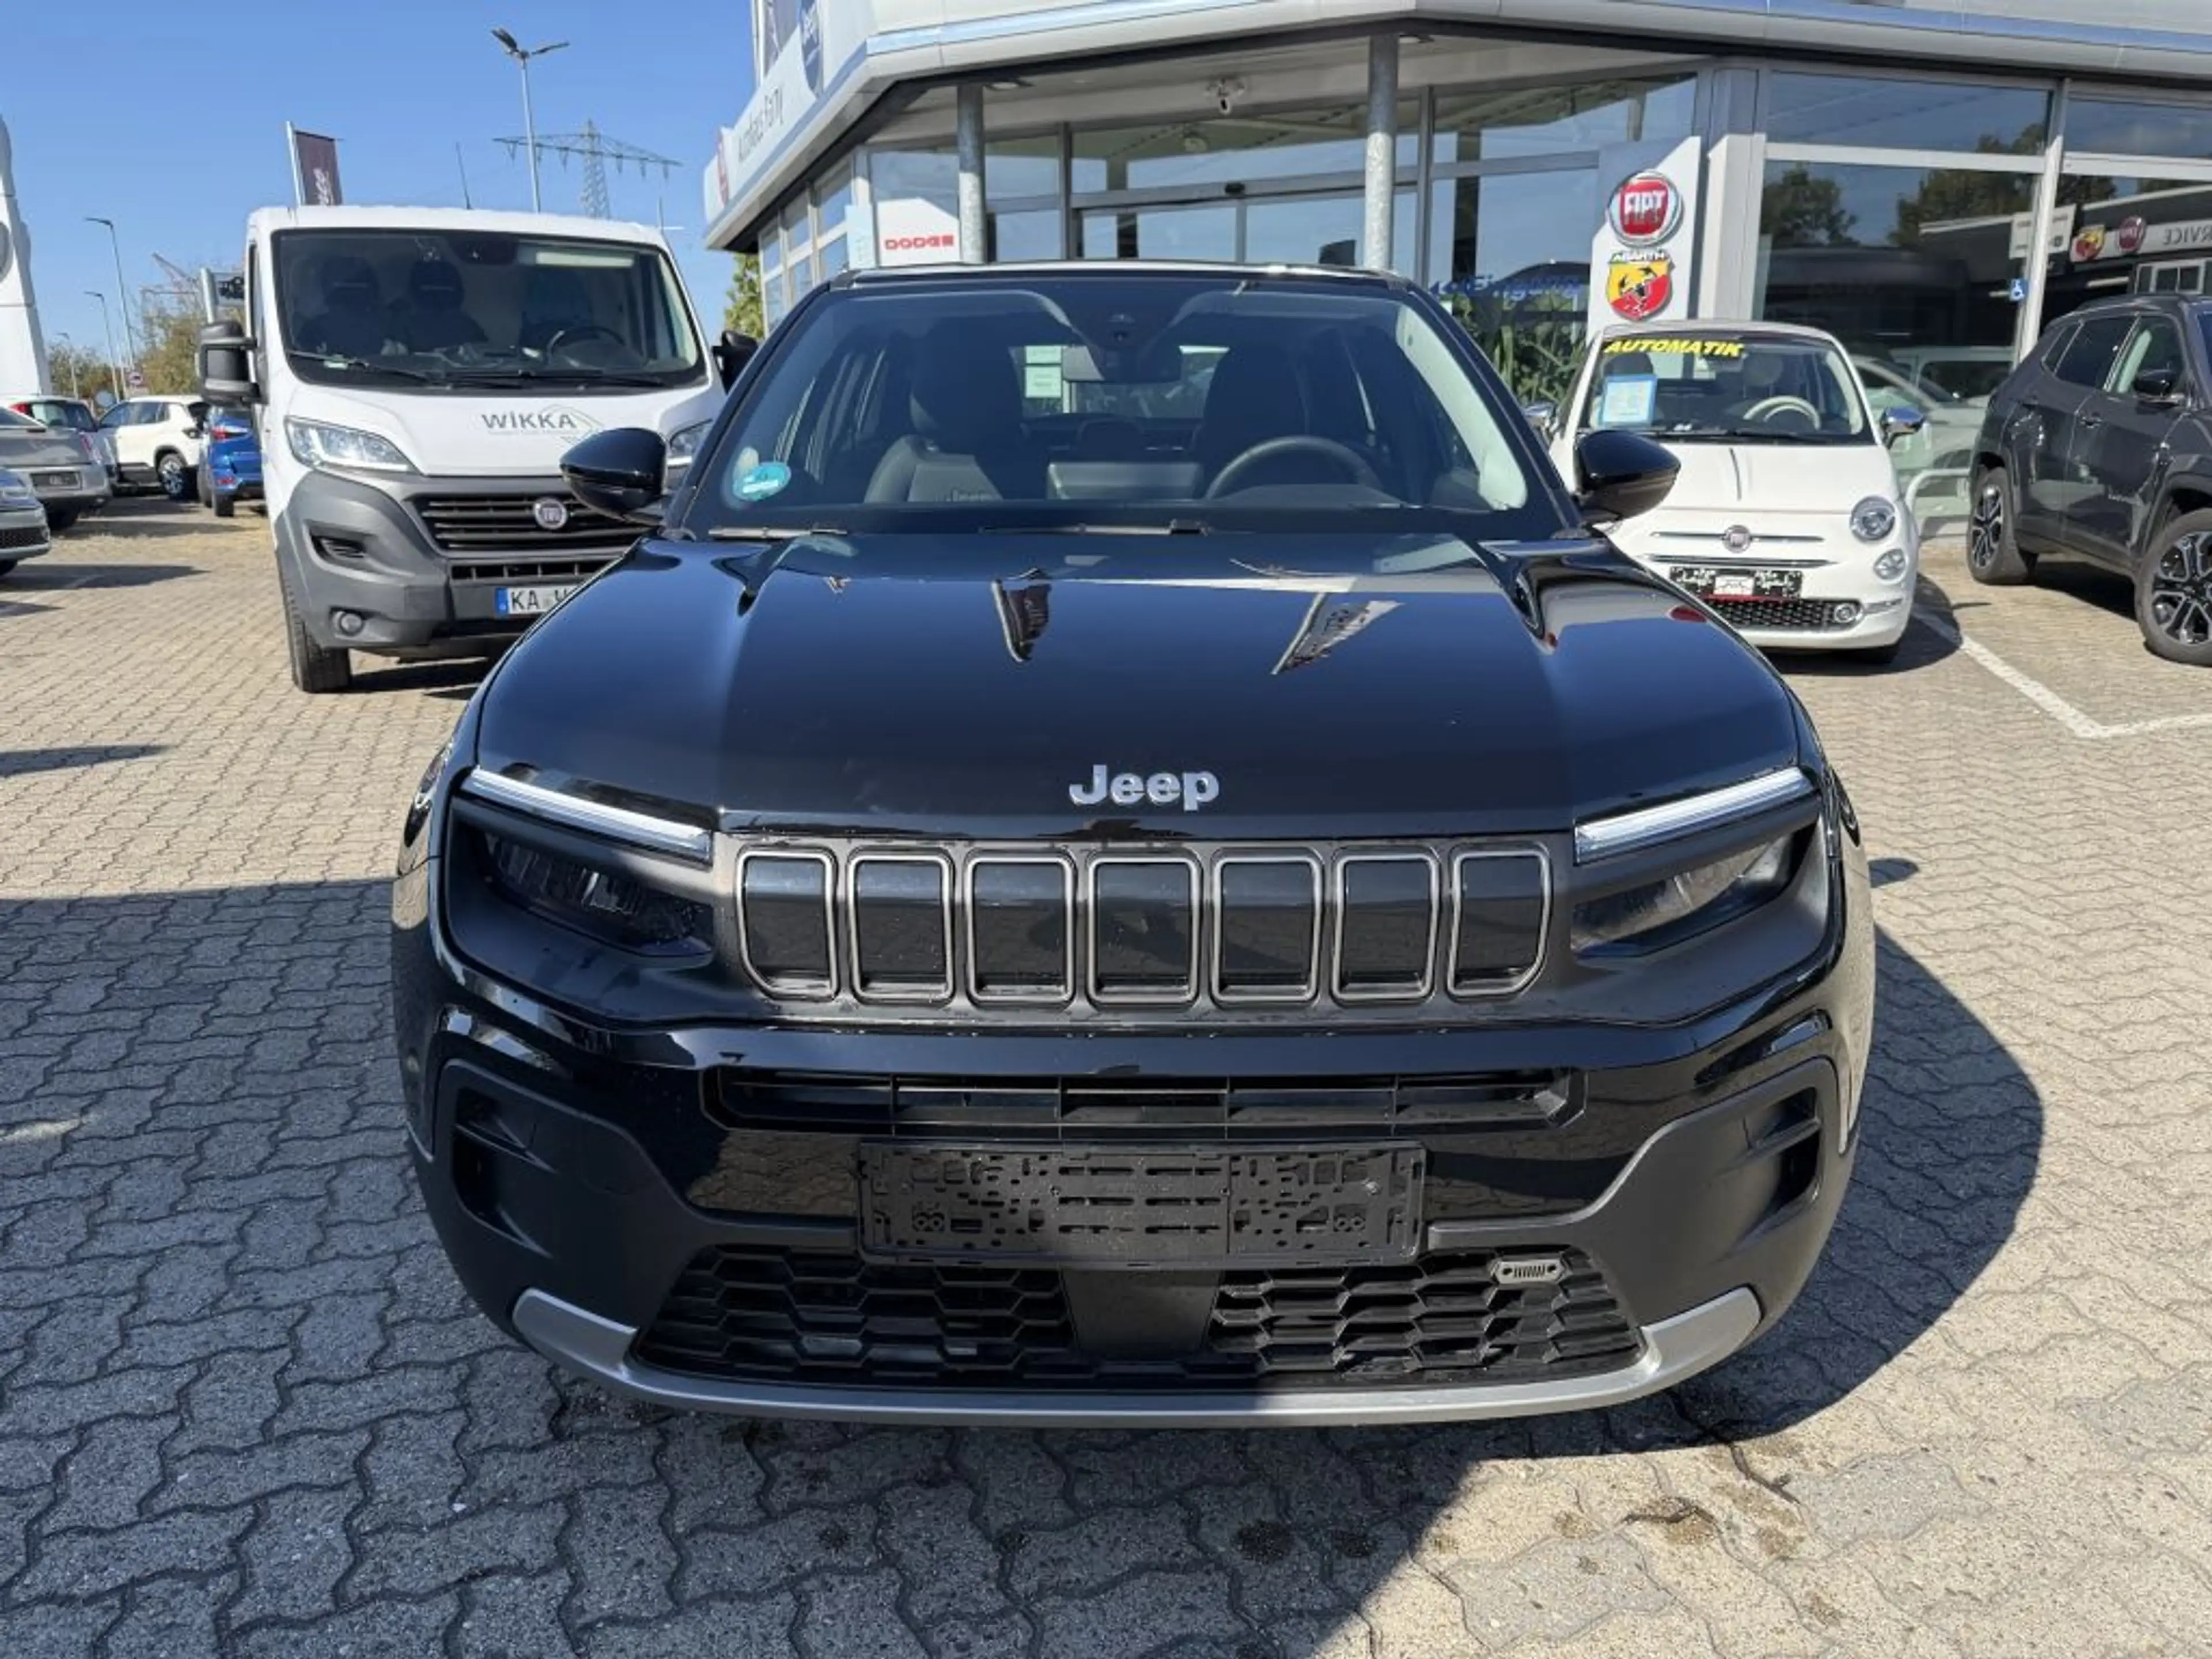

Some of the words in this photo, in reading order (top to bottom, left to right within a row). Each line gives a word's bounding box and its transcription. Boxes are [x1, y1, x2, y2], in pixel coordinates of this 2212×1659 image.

[1624, 190, 1666, 215] FIAT
[885, 234, 954, 250] DODGE
[1604, 338, 1744, 357] AUTOMATIK
[511, 589, 540, 611] KA
[1069, 764, 1219, 811] Jeep
